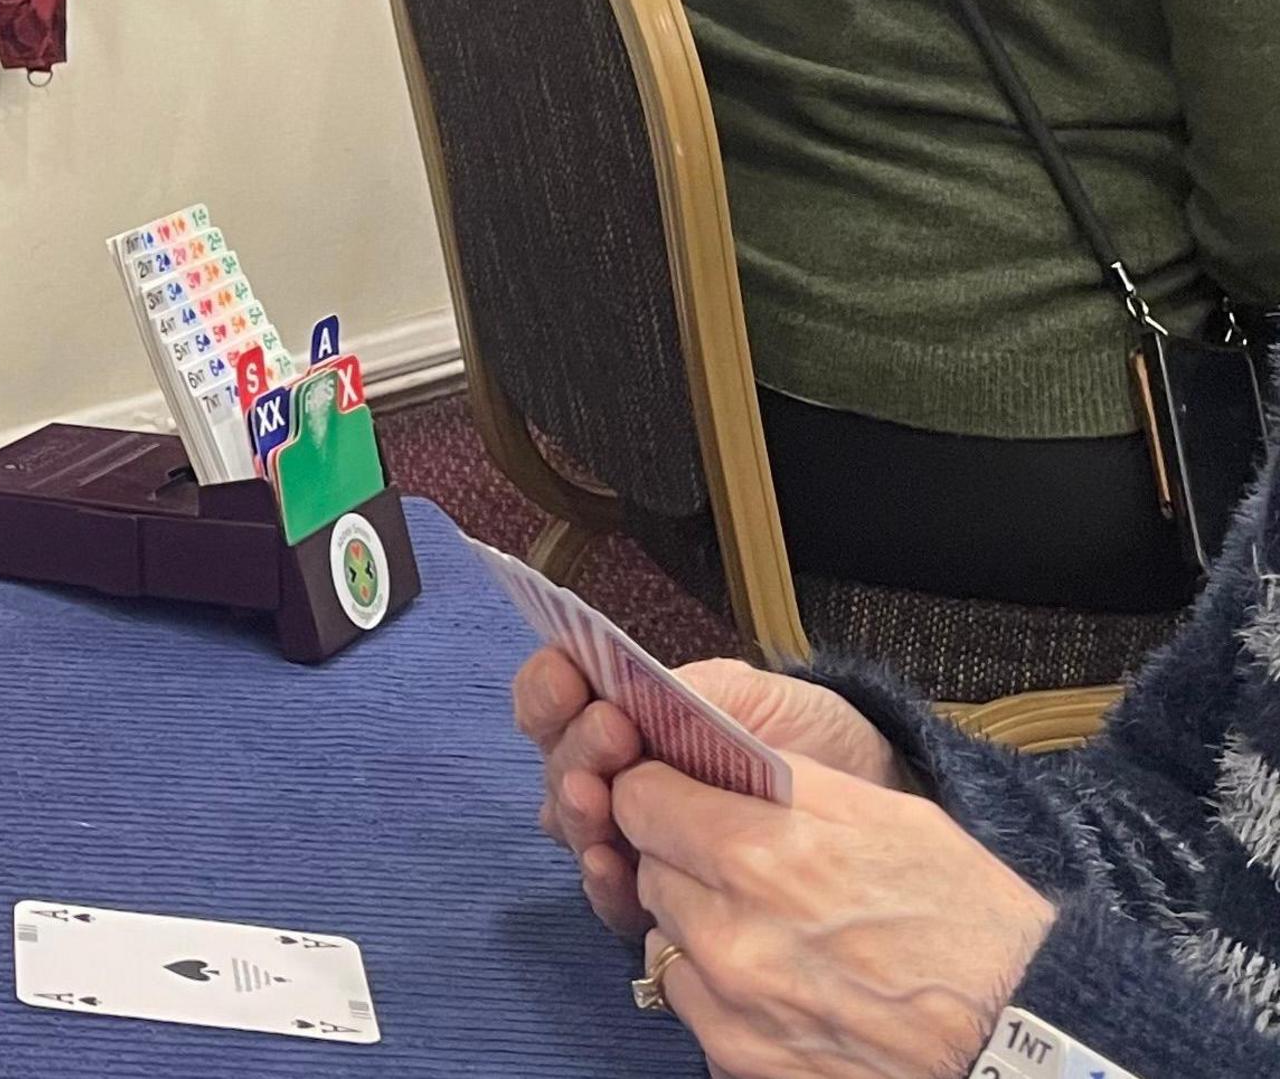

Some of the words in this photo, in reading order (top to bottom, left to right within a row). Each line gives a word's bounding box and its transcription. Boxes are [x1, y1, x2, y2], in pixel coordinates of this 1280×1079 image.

[160, 317, 176, 336] 4NT
[173, 341, 190, 361] 5NT
[318, 327, 333, 359] A
[187, 369, 205, 389] 6NT
[245, 362, 260, 394] S
[338, 364, 359, 409] X
[202, 393, 222, 414] 7NT
[225, 385, 234, 404] 7
[256, 395, 286, 437] XX
[28, 908, 70, 922] A
[302, 936, 342, 949] A
[32, 991, 75, 1005] A
[319, 1020, 363, 1034] A
[1007, 1020, 1053, 1064] 1NT
